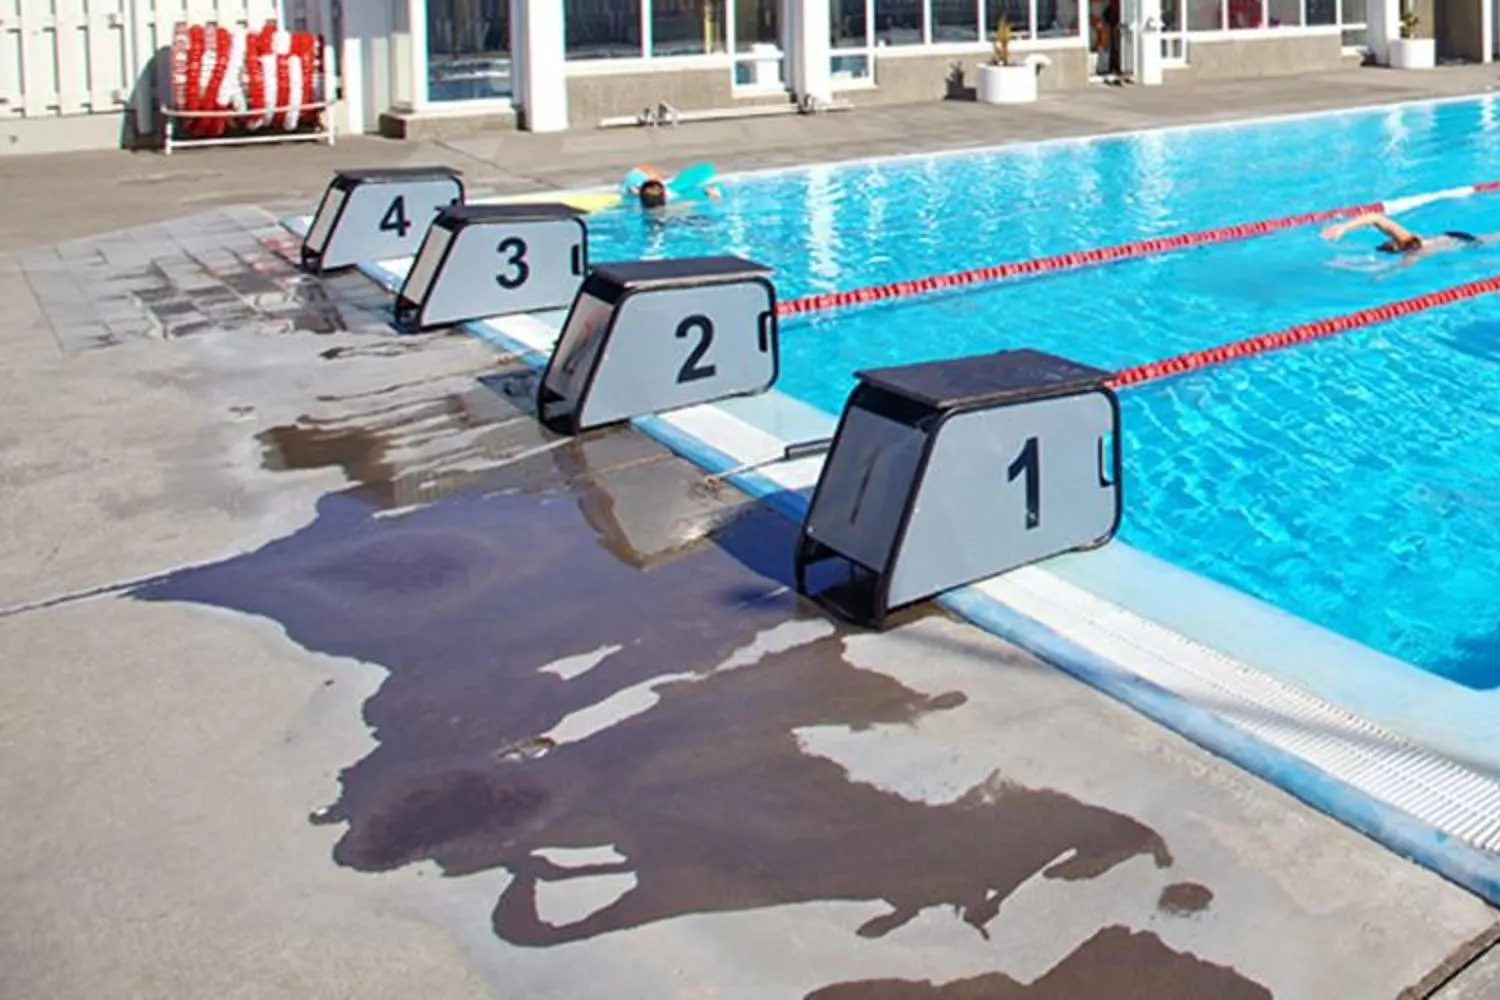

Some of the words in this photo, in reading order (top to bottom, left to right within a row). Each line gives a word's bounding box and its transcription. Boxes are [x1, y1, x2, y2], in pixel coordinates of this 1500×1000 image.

[378, 195, 411, 237] 4
[495, 237, 530, 289] 3
[675, 314, 717, 384] 2
[1007, 436, 1040, 530] 1
